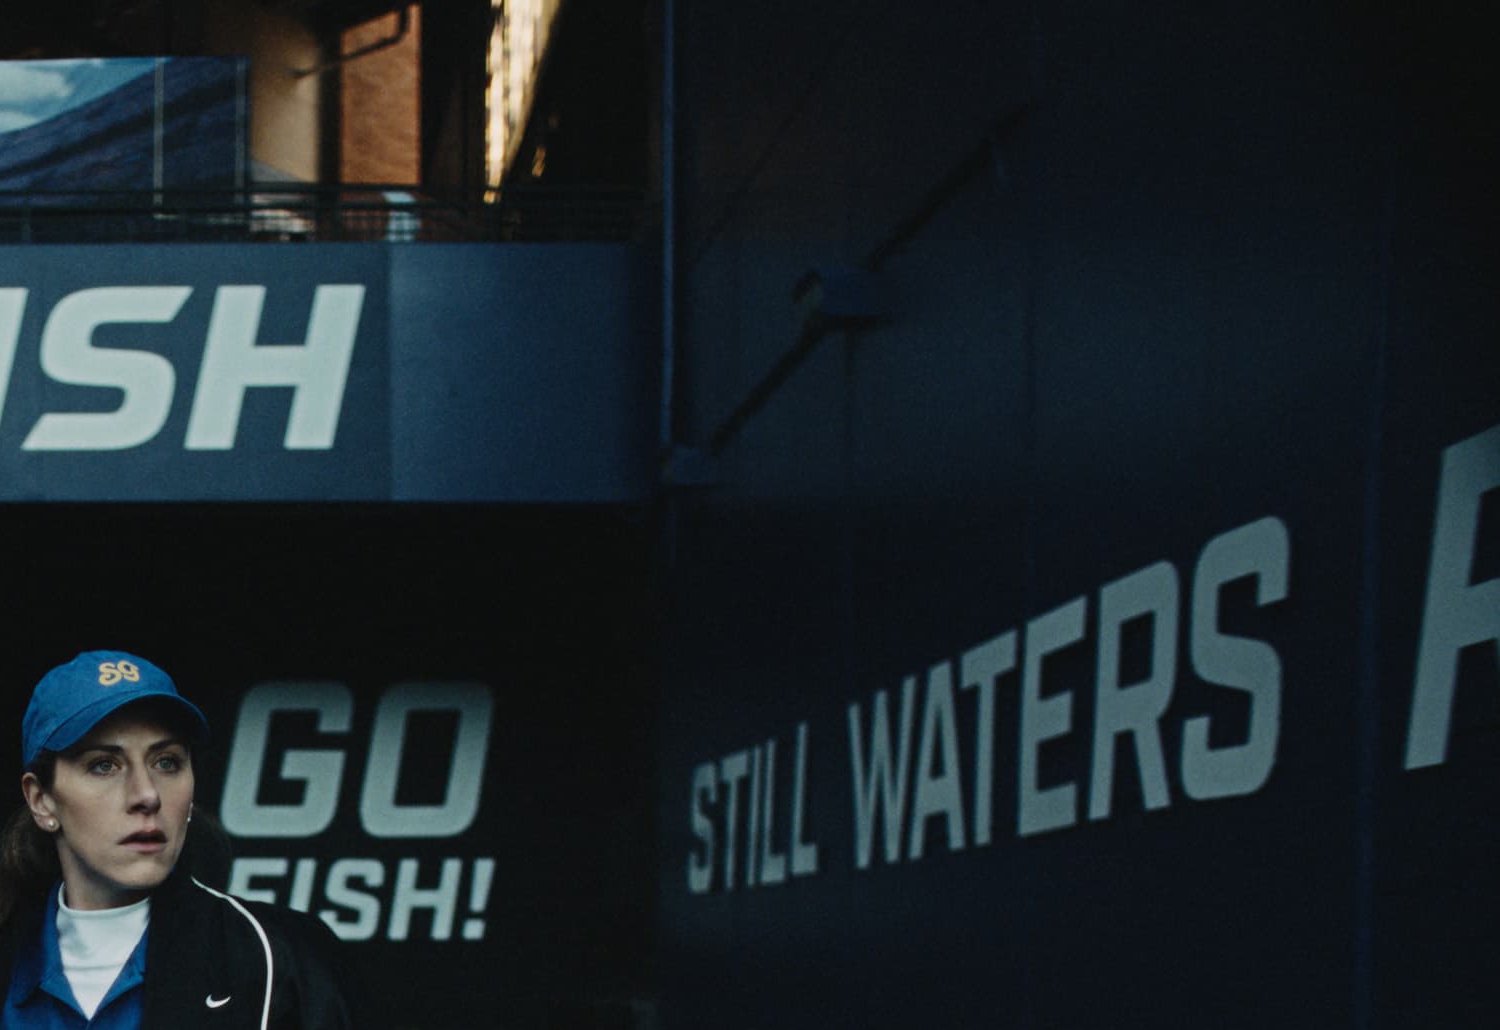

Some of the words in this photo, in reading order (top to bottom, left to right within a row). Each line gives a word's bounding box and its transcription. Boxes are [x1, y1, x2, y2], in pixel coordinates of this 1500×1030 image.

[219, 680, 496, 839] GO
[687, 720, 819, 894] STILL
[847, 515, 1292, 870] WATERS
[227, 856, 497, 942] FISH!
